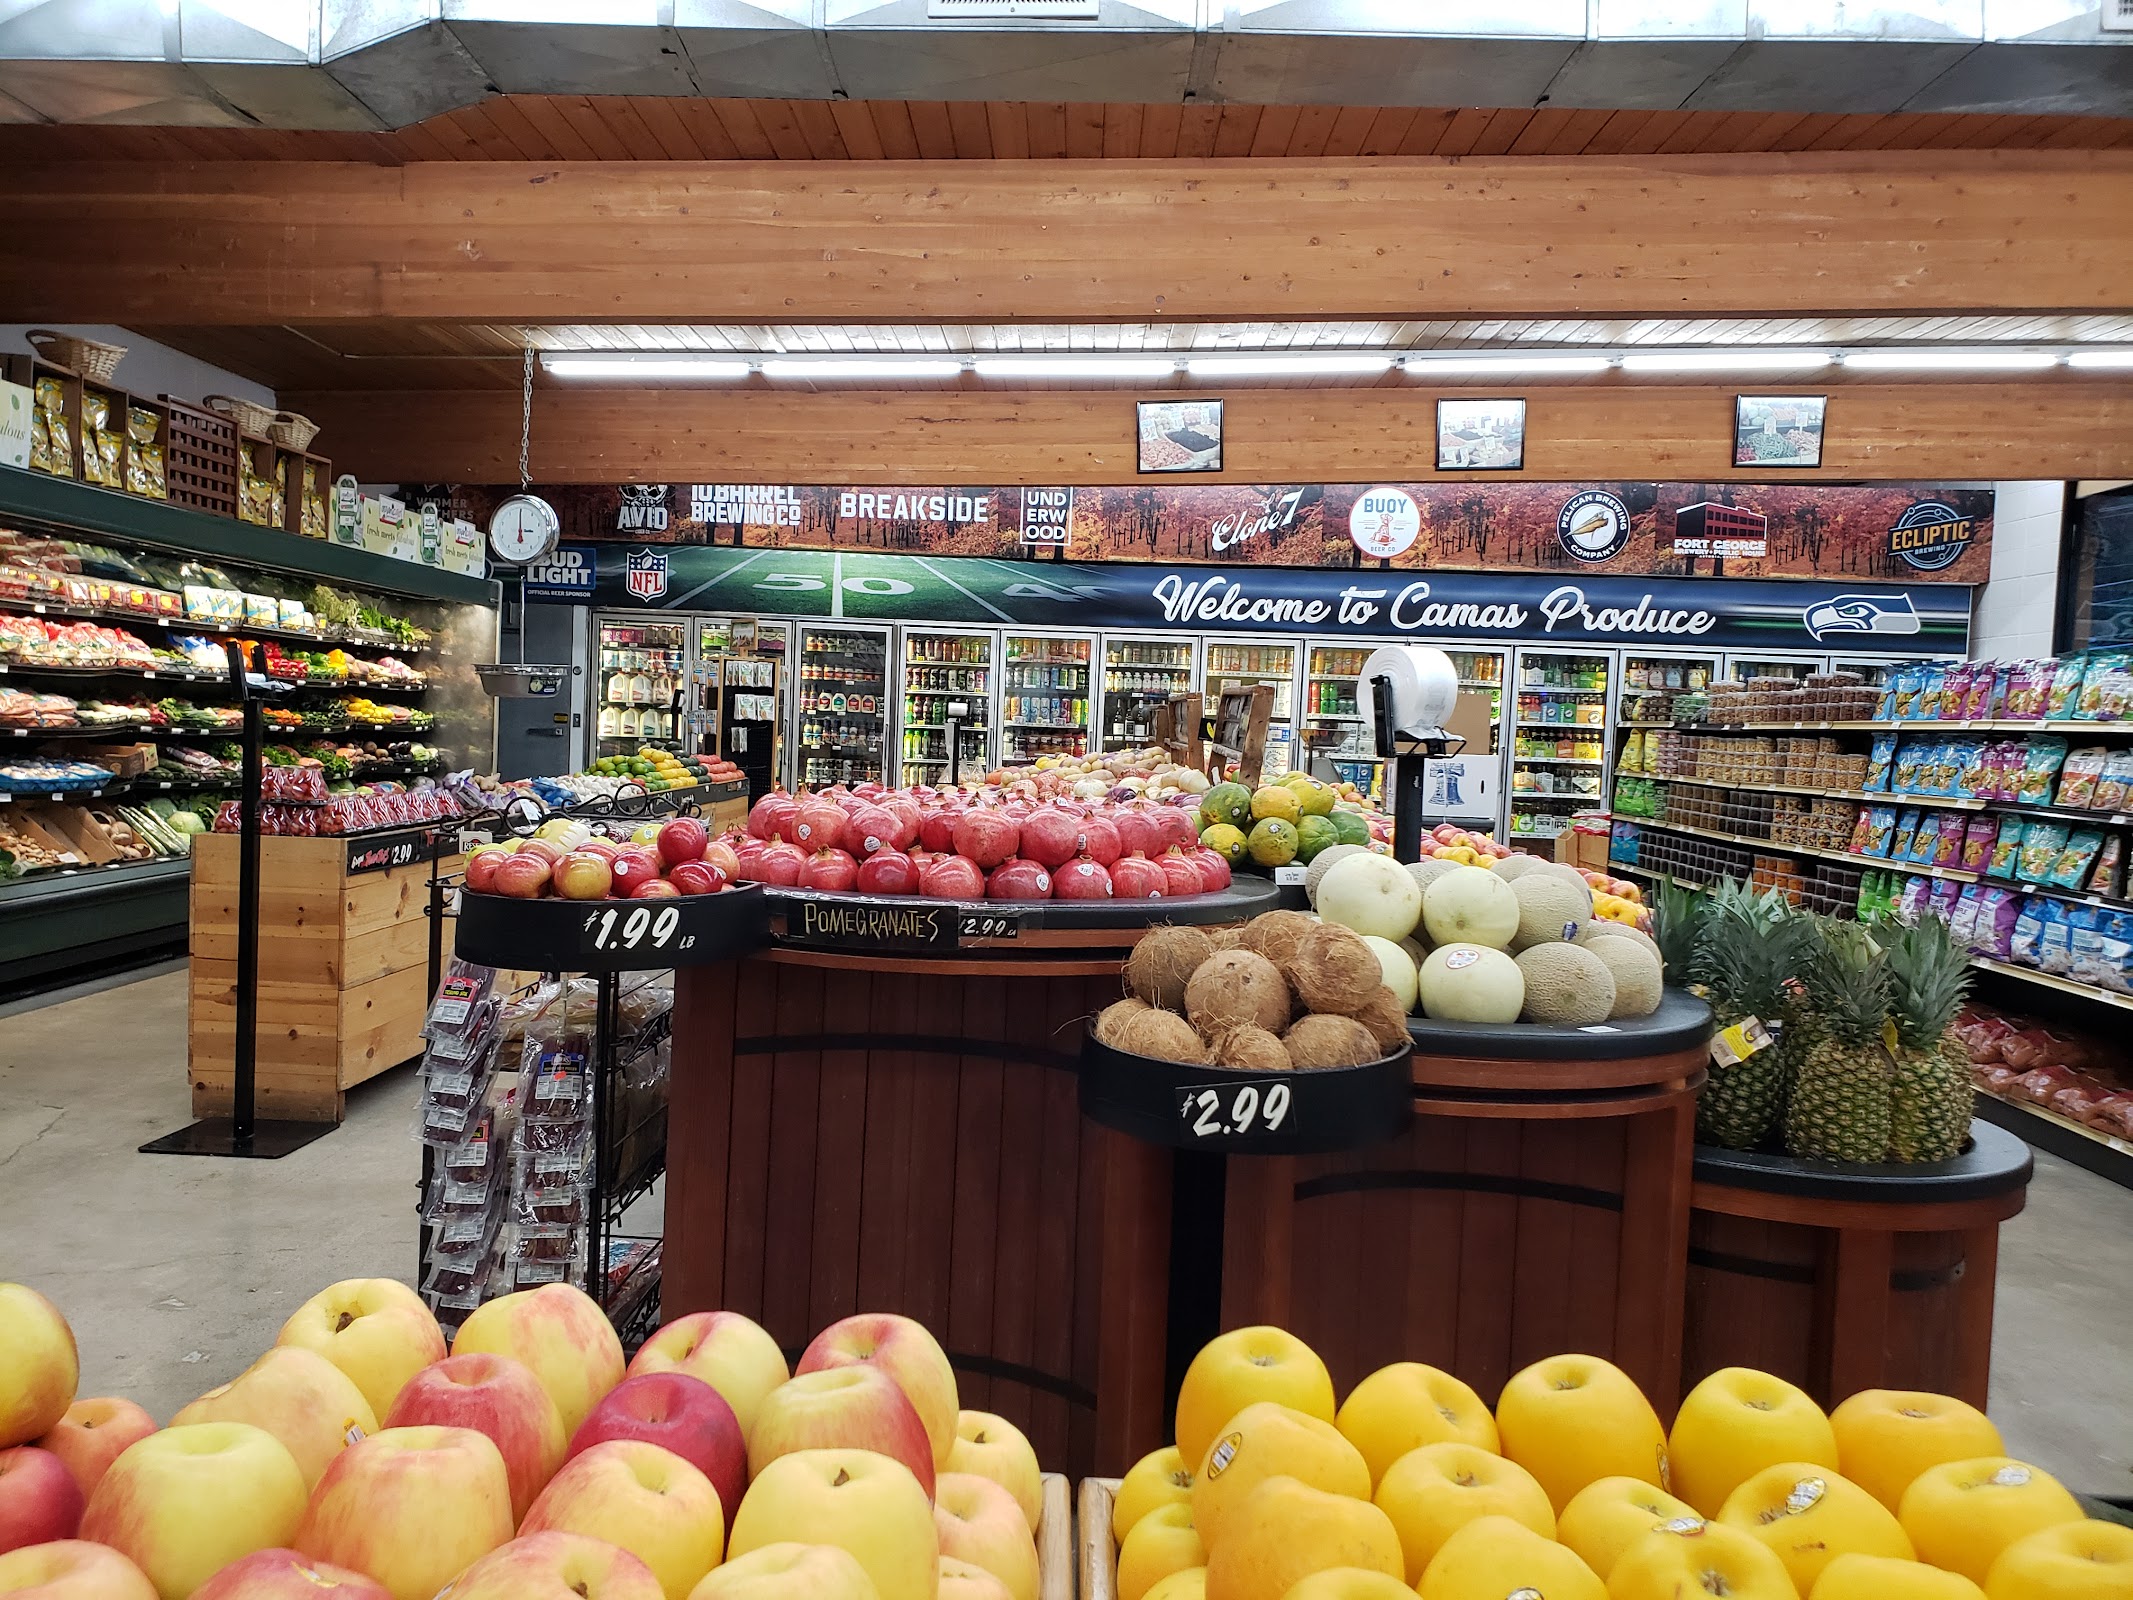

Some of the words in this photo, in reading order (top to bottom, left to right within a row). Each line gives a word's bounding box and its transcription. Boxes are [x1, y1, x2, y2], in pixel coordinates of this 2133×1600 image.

[1027, 491, 1067, 506] UND
[1364, 498, 1408, 513] BUOY
[690, 501, 775, 525] BREWING
[840, 493, 990, 522] BREAKSIDE
[1026, 508, 1067, 523] ERW
[1561, 494, 1593, 528] PELICAN
[1594, 494, 1628, 531] BREWING
[616, 506, 668, 530] AVID
[1025, 525, 1066, 540] OOD
[1892, 521, 1970, 550] ECLIPTIC
[1570, 545, 1616, 559] COMPANY
[1674, 539, 1710, 549] FORT
[1712, 540, 1767, 551] GEORGE
[1914, 545, 1946, 555] BREWING
[527, 566, 592, 585] LIGHT
[631, 571, 663, 593] NFL
[565, 590, 591, 598] SPONSOR
[1152, 574, 1332, 624] Welcome
[1339, 586, 1388, 625] to
[1389, 581, 1528, 630] Camas
[1539, 585, 1717, 635] Produce
[803, 903, 939, 942] POMEGRANATES
[679, 935, 697, 951] LB
